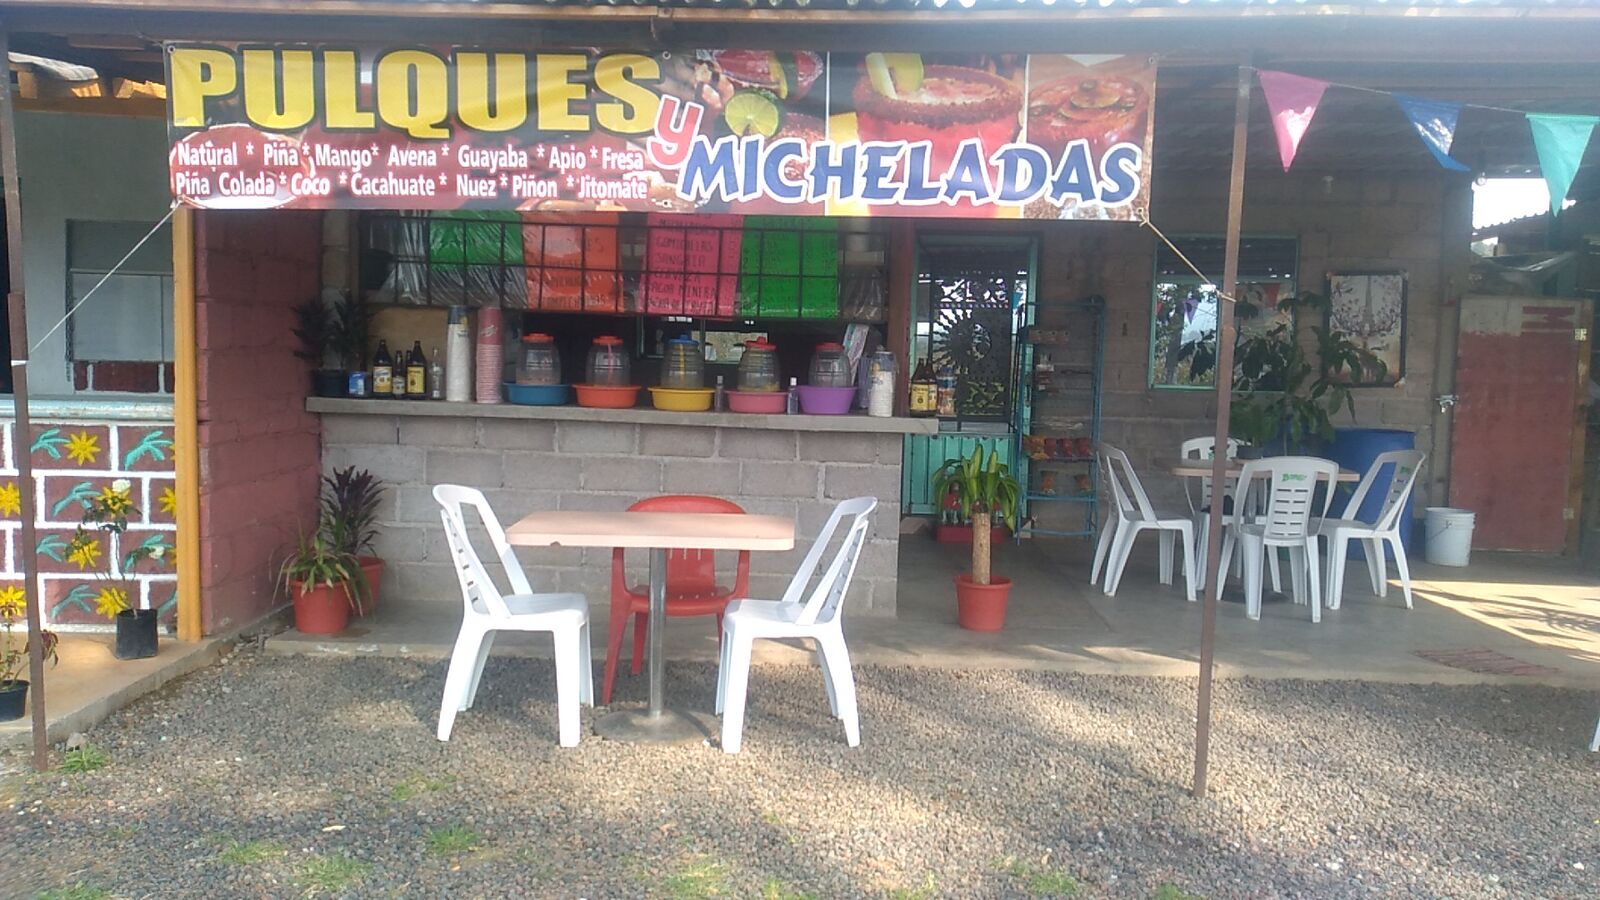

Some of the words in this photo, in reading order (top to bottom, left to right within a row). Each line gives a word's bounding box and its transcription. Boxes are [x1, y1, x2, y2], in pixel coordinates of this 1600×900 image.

[170, 47, 662, 140] PULQUES
[178, 141, 238, 167] Natural
[263, 142, 298, 167] Piña
[315, 144, 372, 171] Mango
[387, 144, 437, 167] Avena
[457, 144, 528, 173] Guayaba
[548, 146, 586, 174] Apio
[601, 146, 644, 170] Fresa
[678, 137, 1142, 206] MICHELADAS
[175, 171, 210, 195] Piña
[218, 172, 274, 196] Colada
[291, 173, 330, 195] Coco
[350, 172, 436, 196] Cacahuate
[455, 173, 497, 197] Nuez
[512, 173, 558, 198] Piñon
[577, 175, 648, 199] Jitomate
